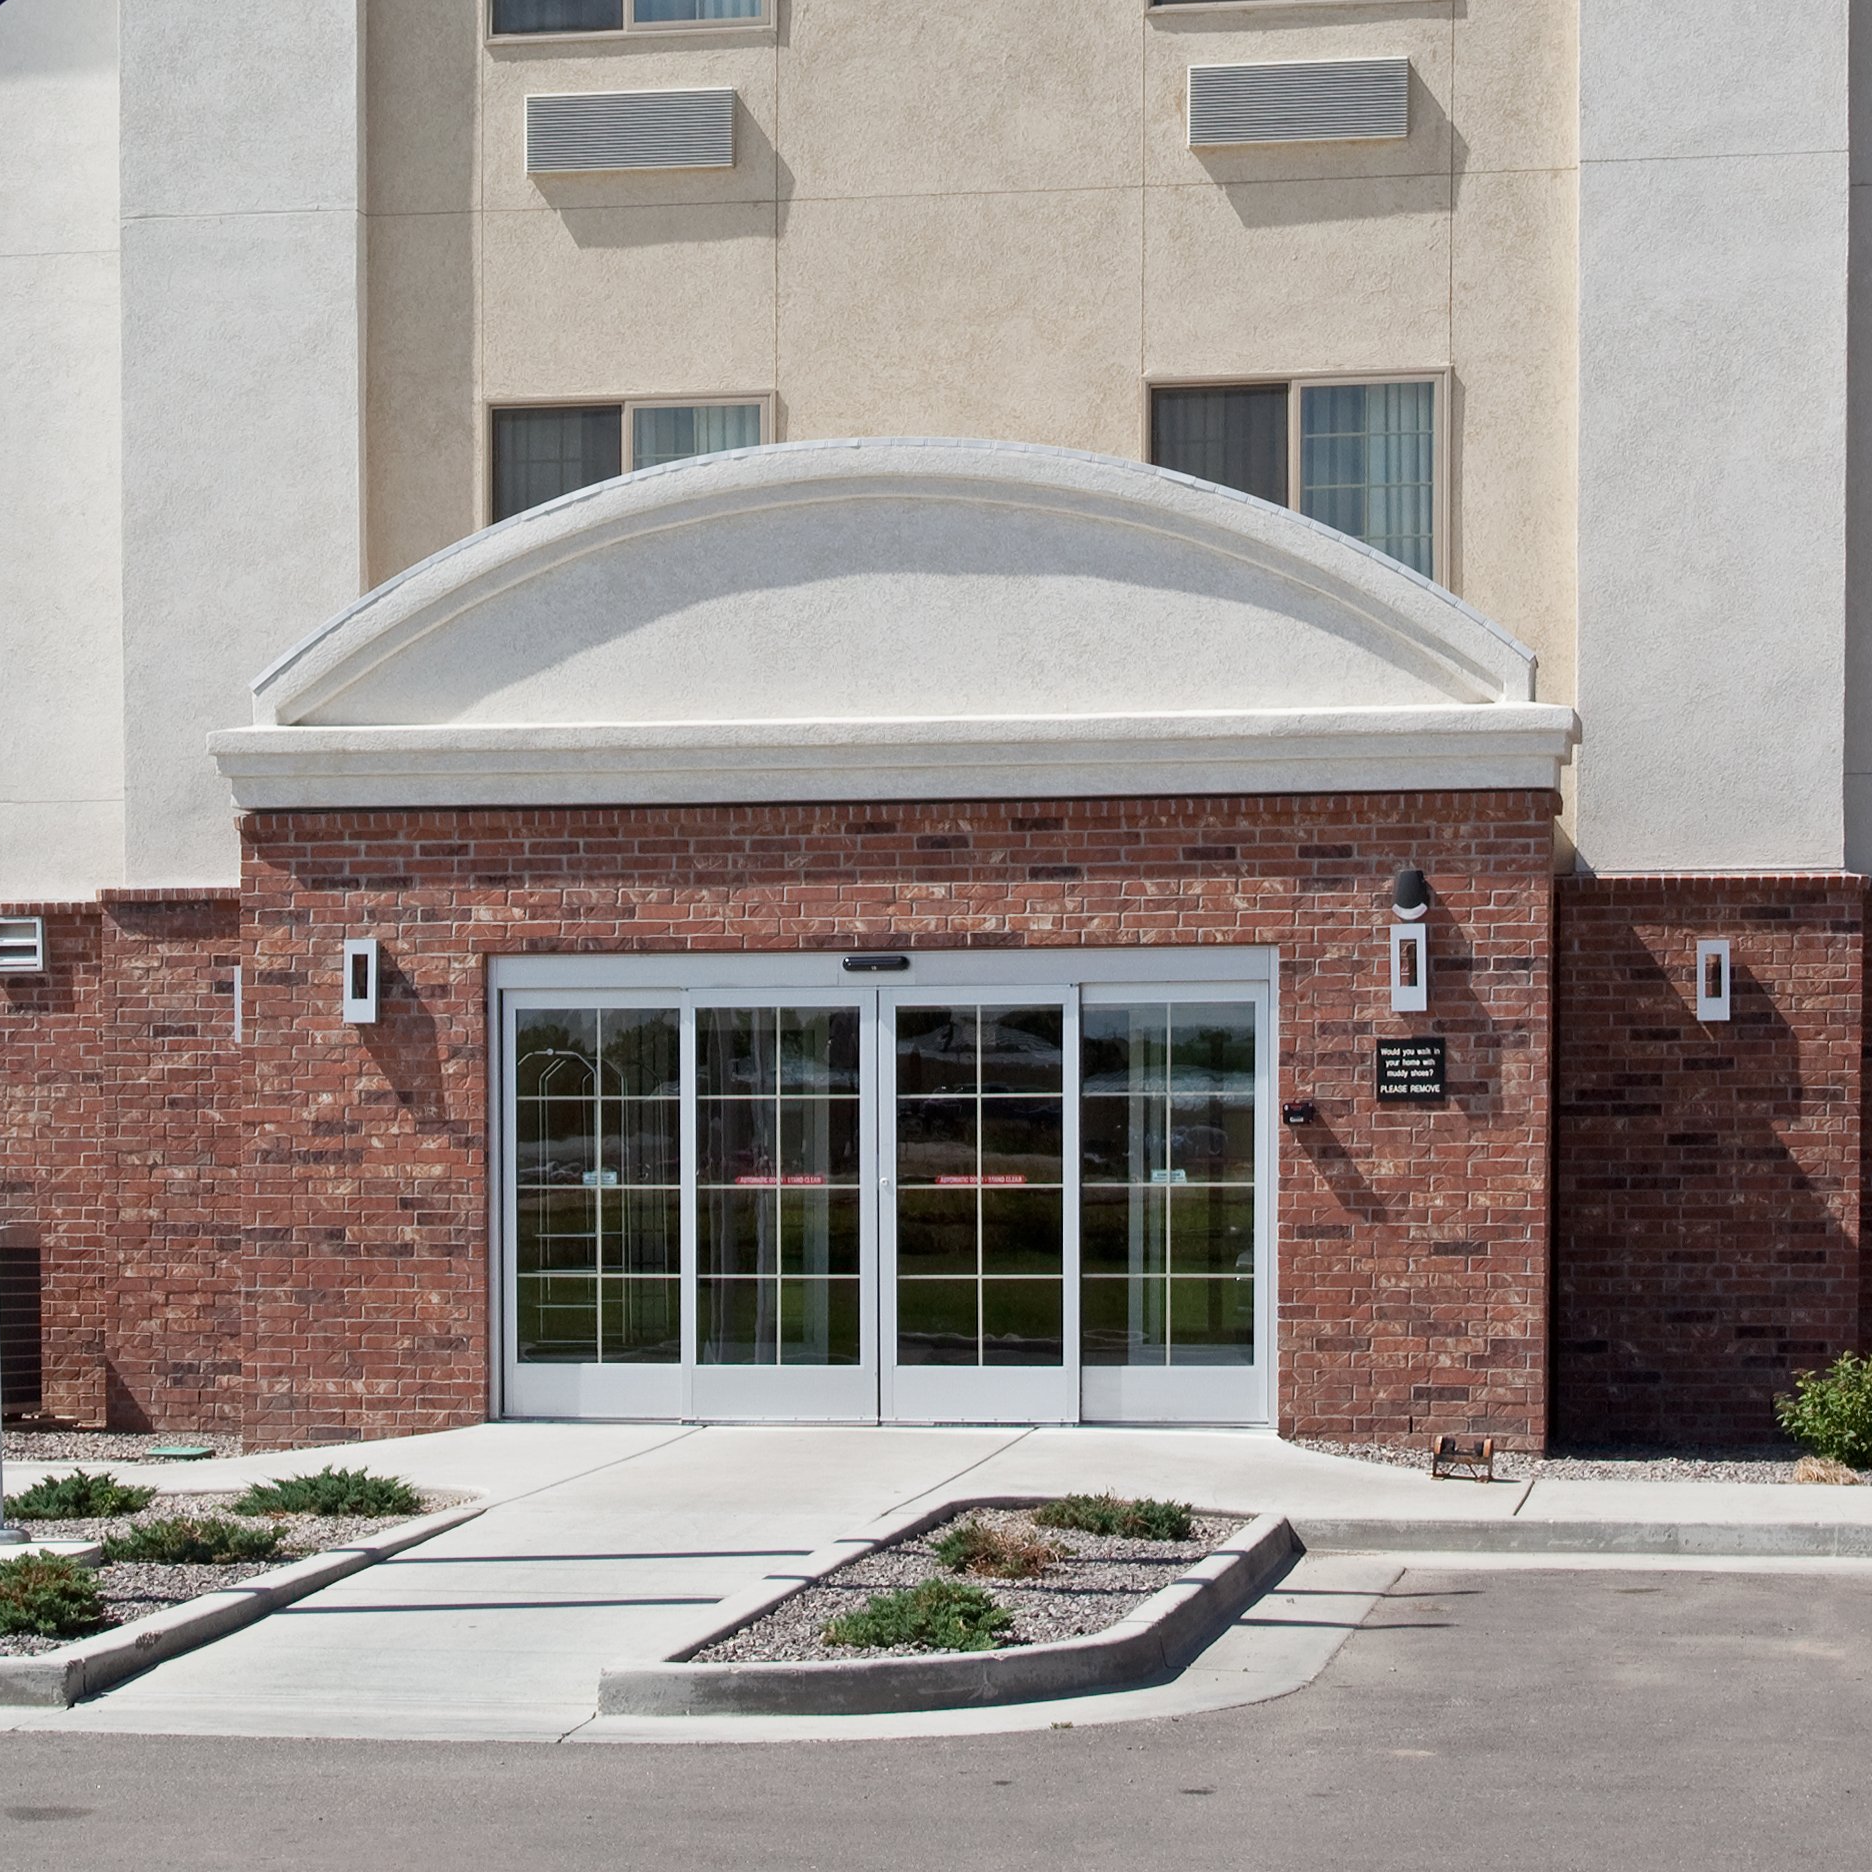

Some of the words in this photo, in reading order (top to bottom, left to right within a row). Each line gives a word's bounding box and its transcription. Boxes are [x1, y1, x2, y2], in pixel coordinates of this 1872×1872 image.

[1385, 1060, 1400, 1068] your
[1387, 1070, 1408, 1078] muddy
[1380, 1085, 1407, 1093] PLEASE
[1410, 1084, 1440, 1093] REMOVE
